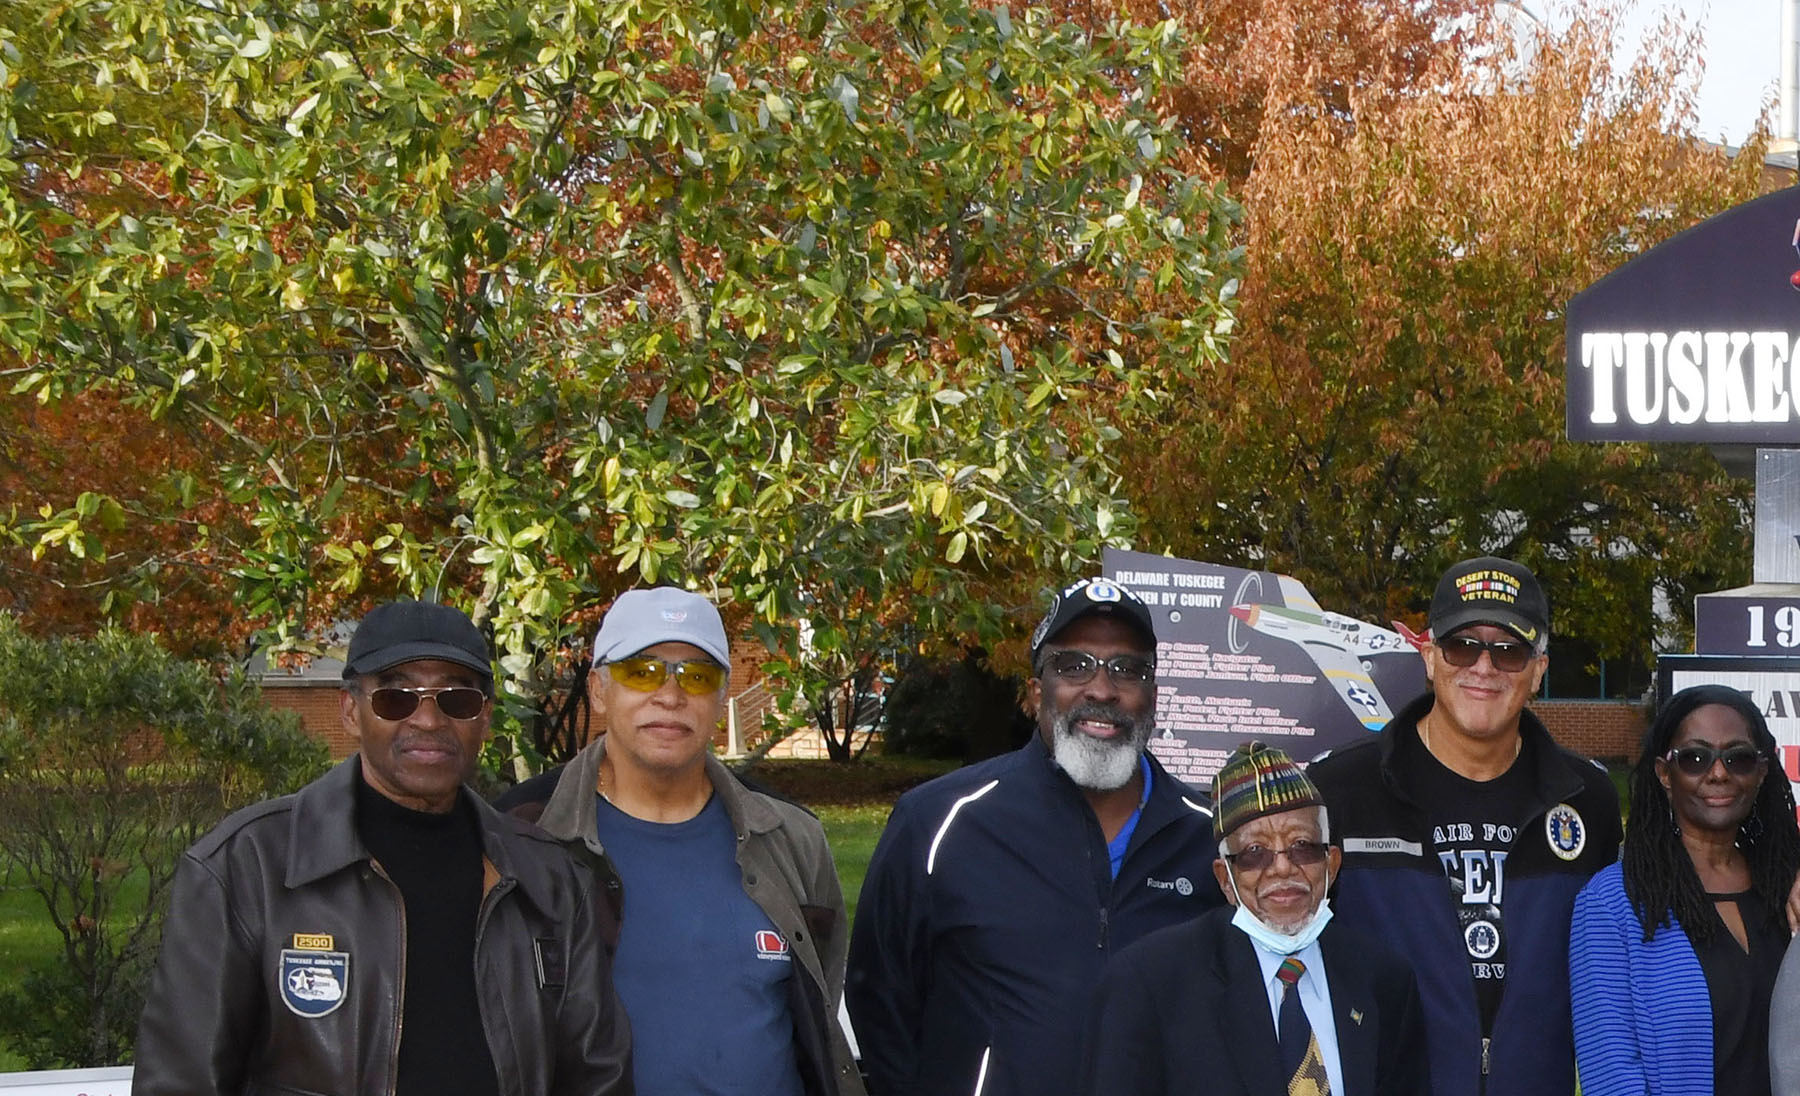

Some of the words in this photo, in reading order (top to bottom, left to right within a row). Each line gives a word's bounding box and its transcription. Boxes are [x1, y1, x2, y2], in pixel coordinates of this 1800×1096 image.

[1116, 571, 1169, 585] DELAWARE
[1173, 574, 1225, 589] TUSKEGEE
[1456, 570, 1490, 588] DESERT
[1492, 570, 1521, 590] STORM
[1162, 593, 1177, 606] BY
[1181, 595, 1223, 608] COUNTY
[1461, 590, 1515, 604] VETERAN
[1343, 633, 1359, 645] A4
[1393, 638, 1401, 649] 2
[1433, 823, 1474, 844] AIR
[1365, 840, 1400, 850] BROWN
[1146, 877, 1174, 890] Rotary
[299, 938, 328, 947] 2500
